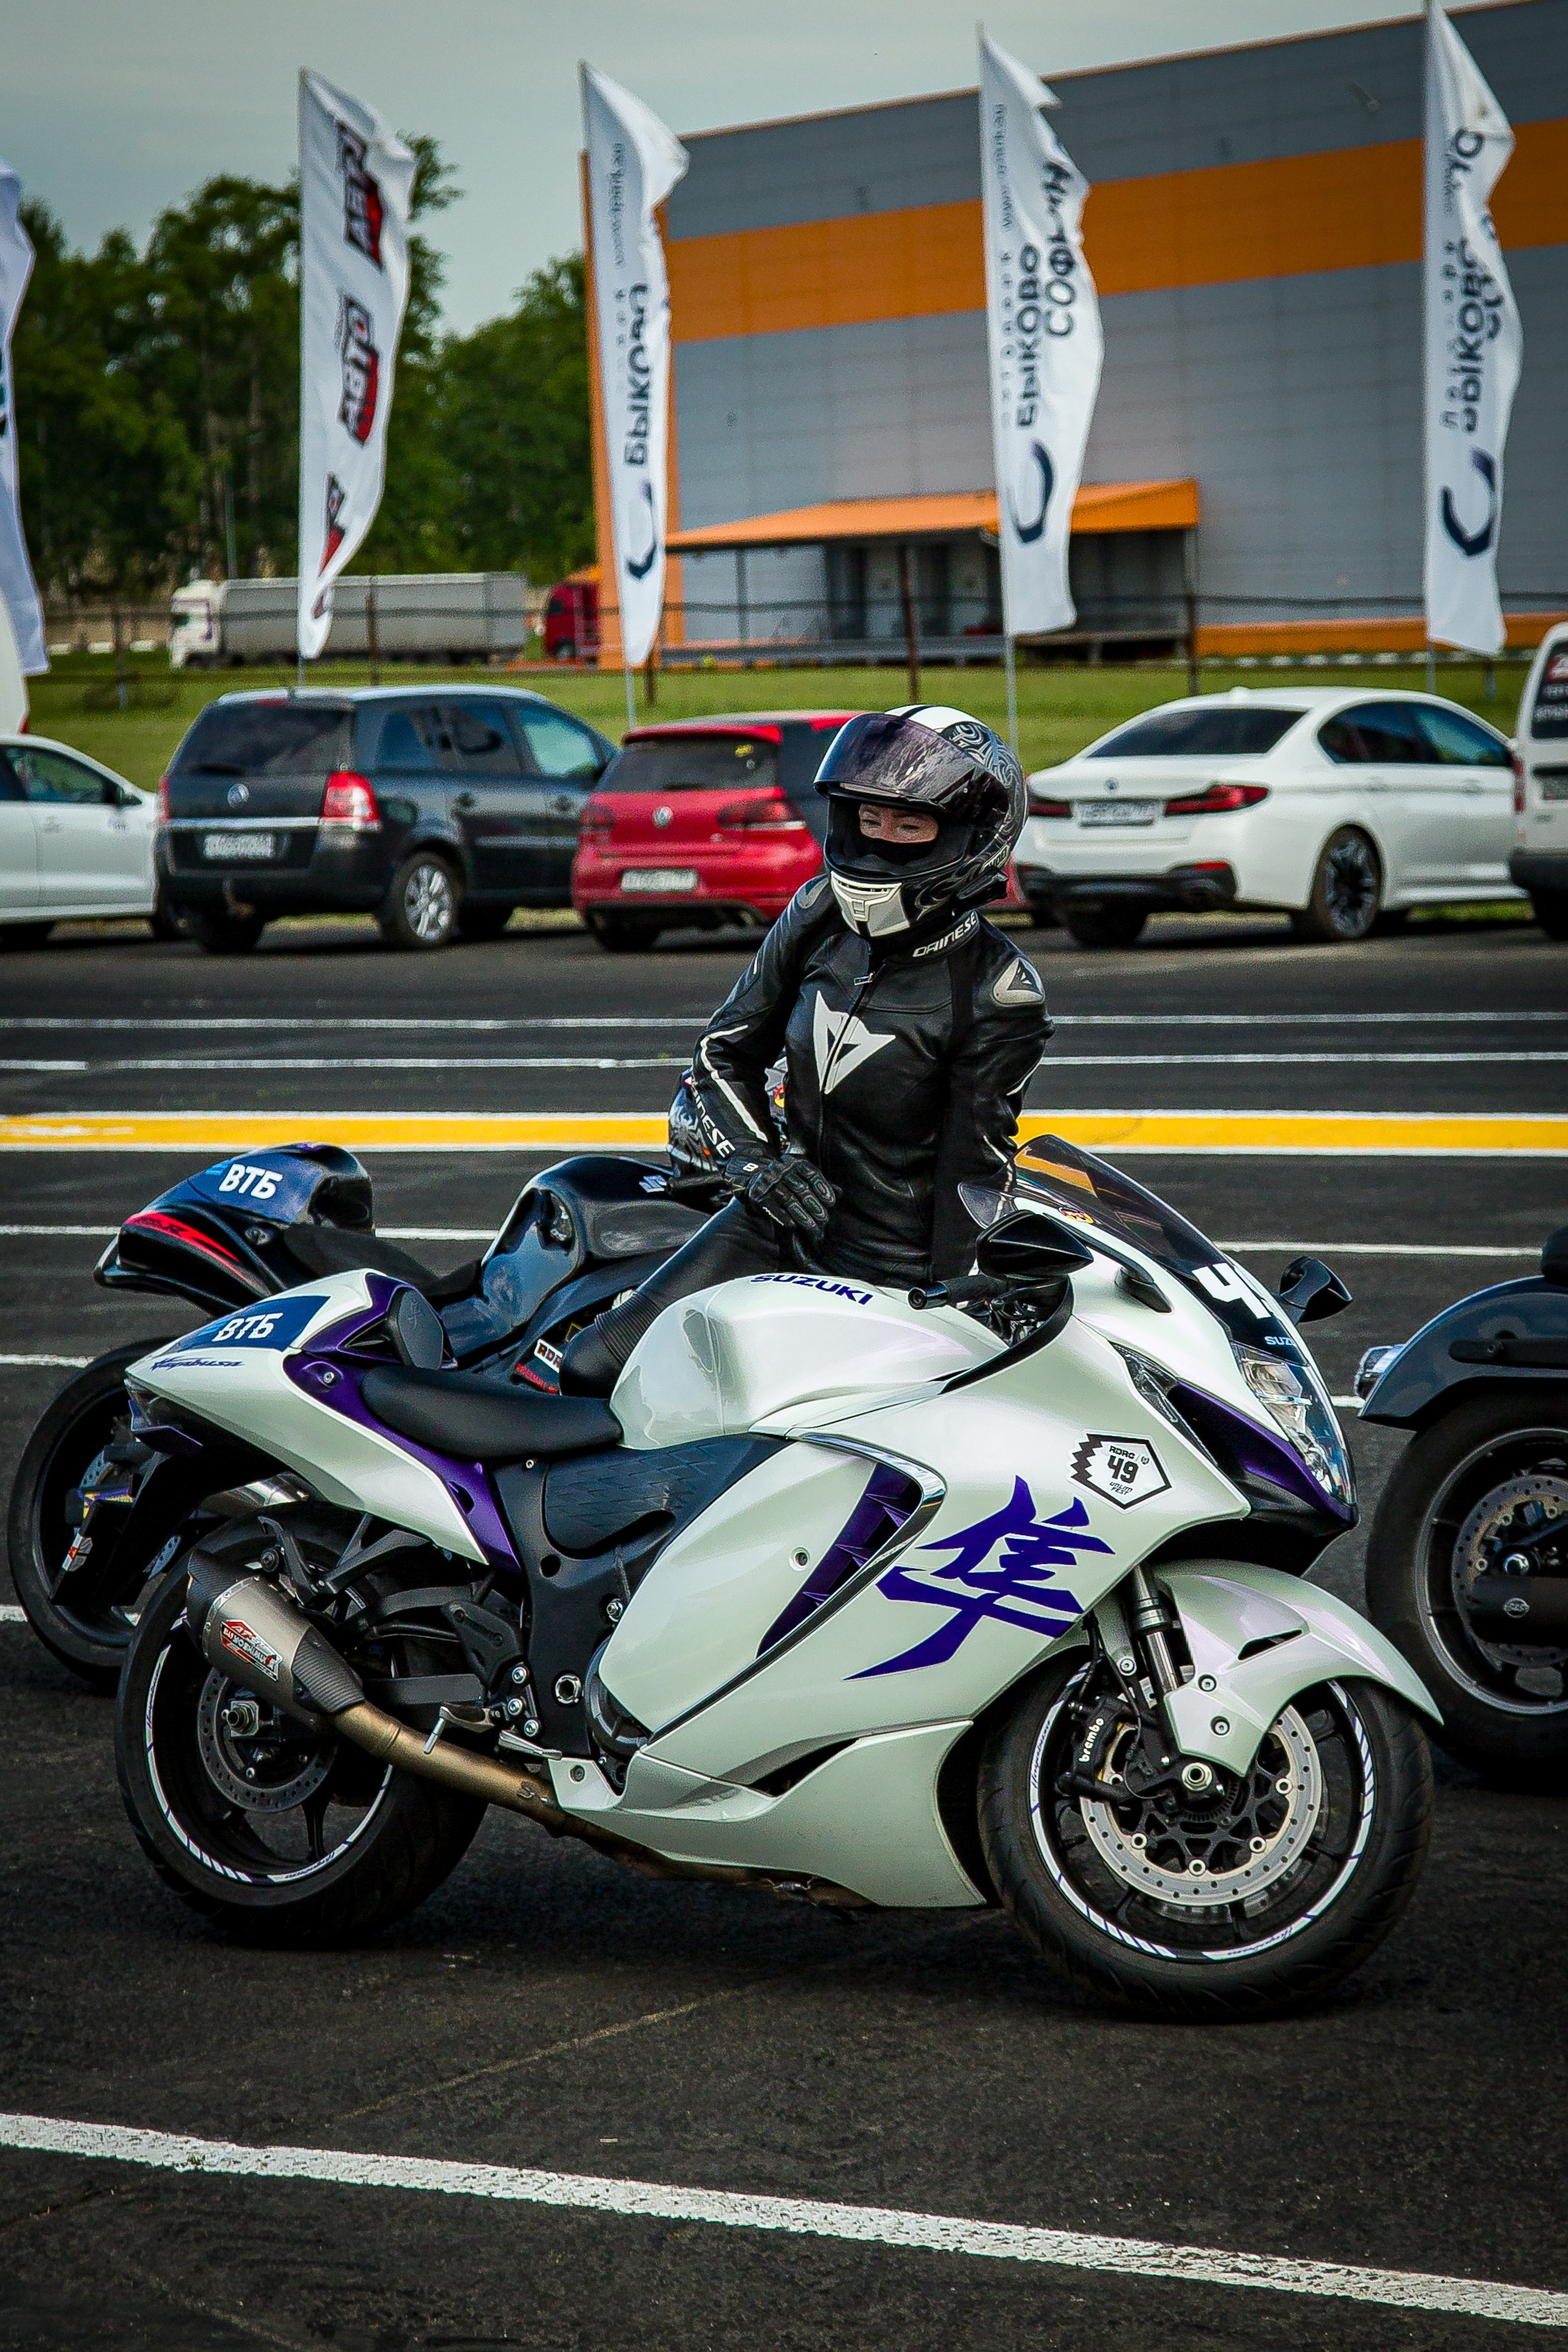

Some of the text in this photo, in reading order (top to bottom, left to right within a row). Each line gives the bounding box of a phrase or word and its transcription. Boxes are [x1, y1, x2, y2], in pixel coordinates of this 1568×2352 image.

[913, 912, 977, 956] DAINESE
[219, 1164, 283, 1199] ВТБ
[750, 1274, 873, 1305] SUZUKI
[212, 1313, 283, 1341] ВТБ
[1109, 1445, 1135, 1459] RDRC
[1107, 1455, 1139, 1484] 49
[1111, 1487, 1130, 1495] FEST
[1078, 1718, 1104, 1762] brembo
